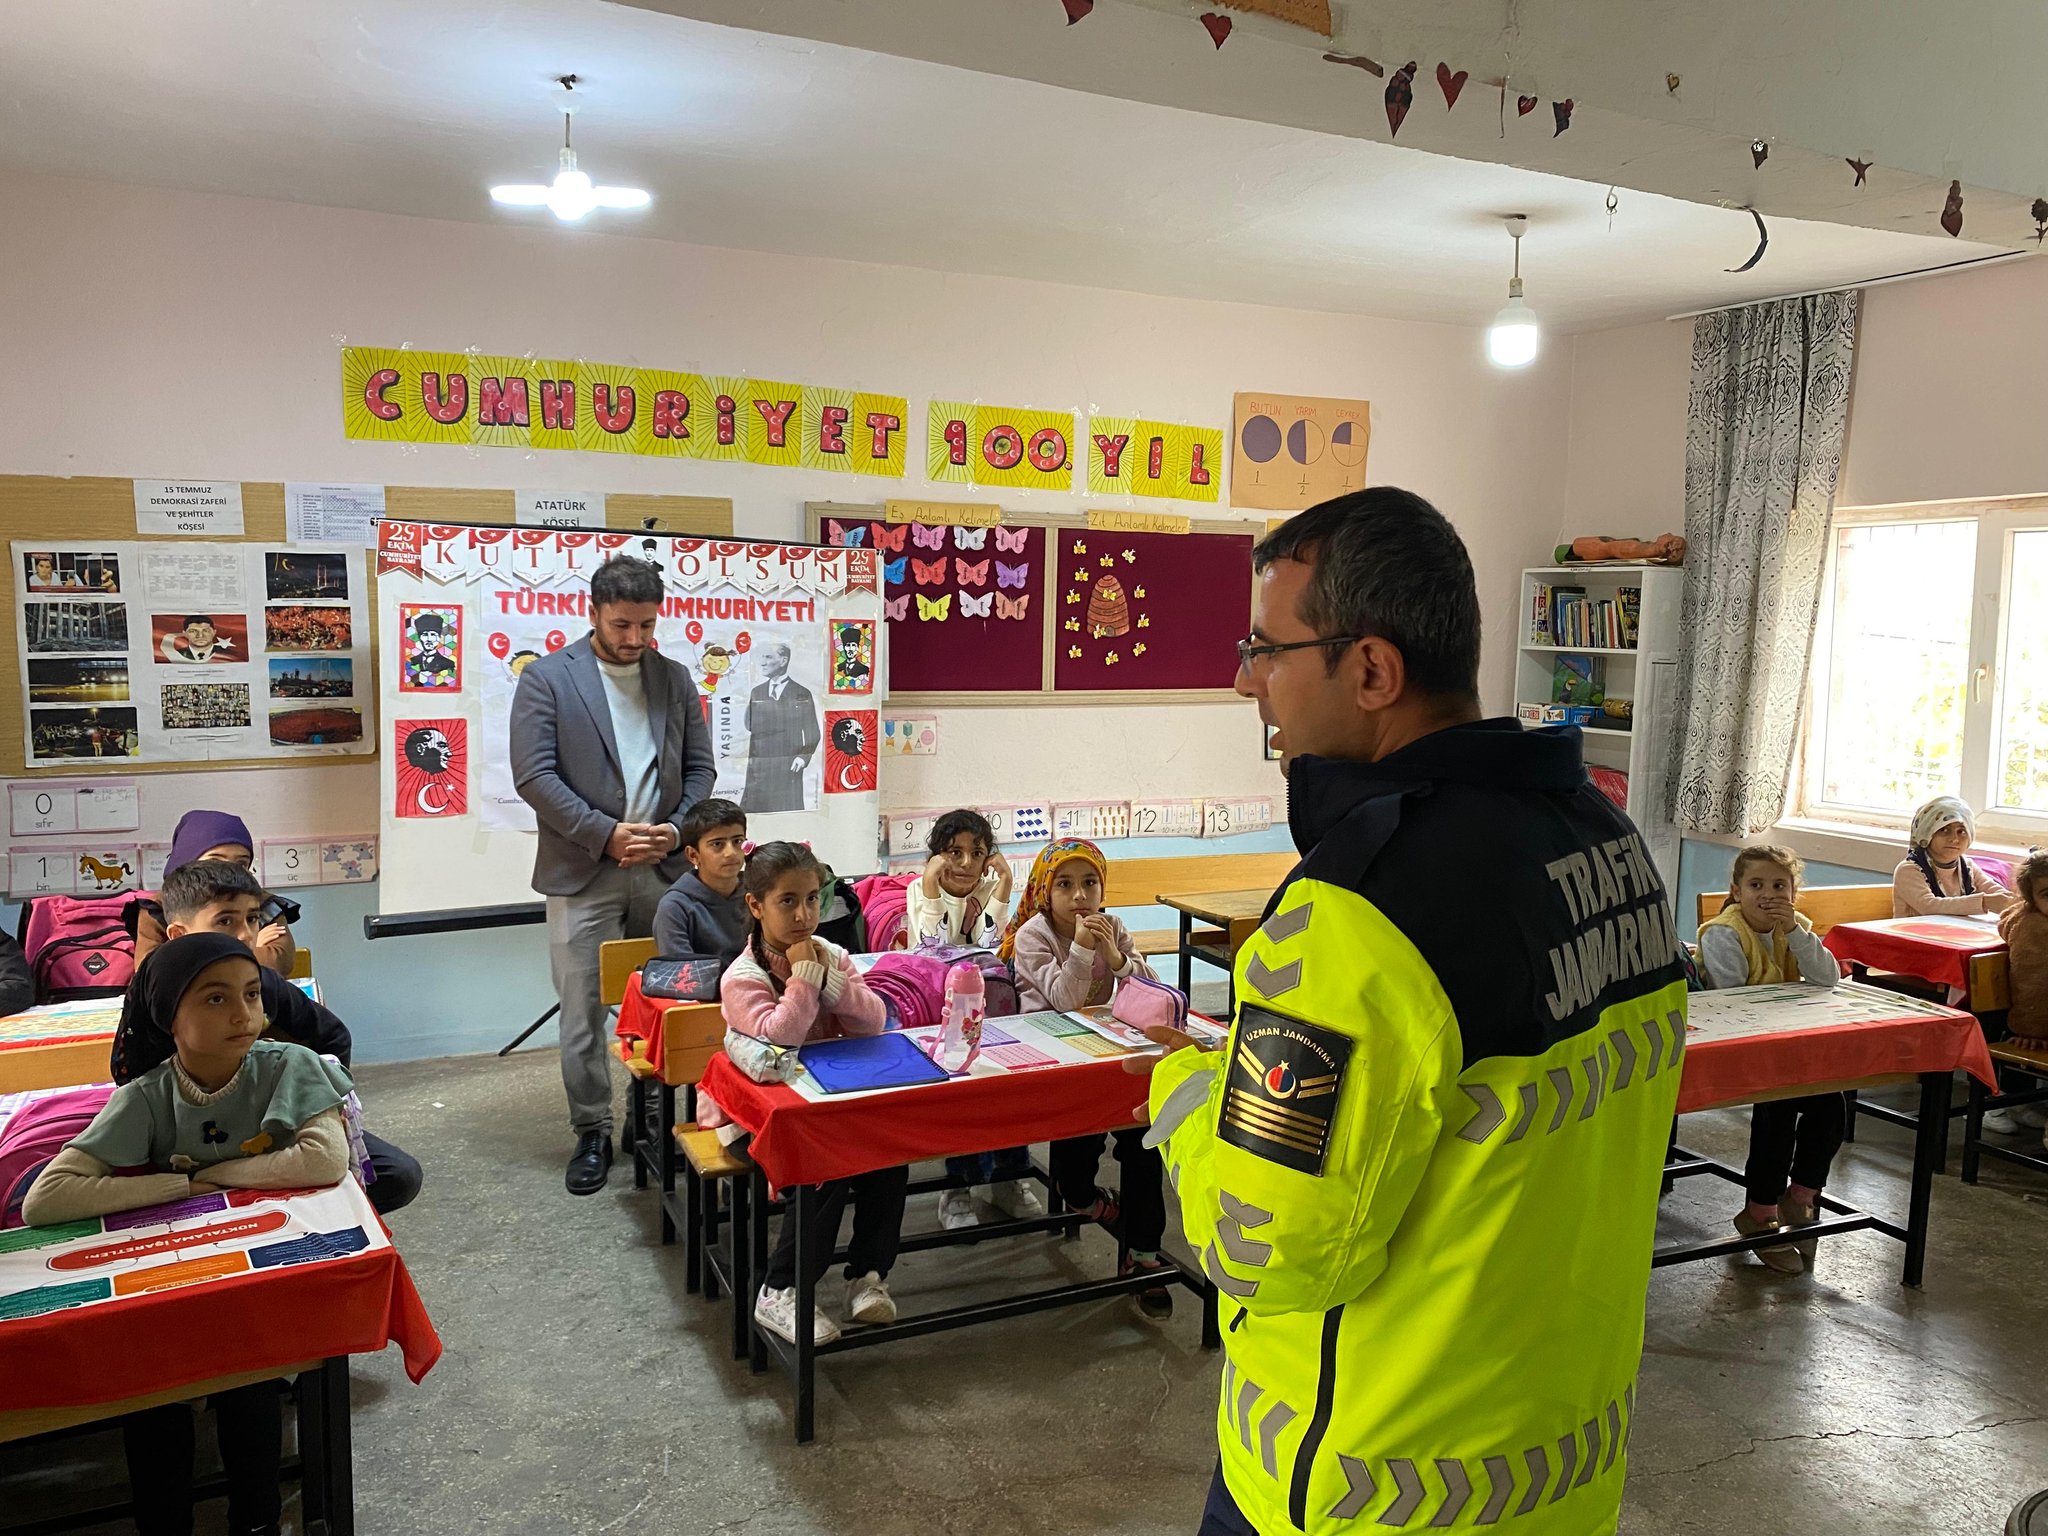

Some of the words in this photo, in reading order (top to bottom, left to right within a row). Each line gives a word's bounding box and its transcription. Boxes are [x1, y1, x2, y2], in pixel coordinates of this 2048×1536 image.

[364, 367, 901, 459] CUMHURİYET
[943, 419, 1073, 473] 100.
[1092, 433, 1211, 485] YIL
[164, 486, 174, 494] 15
[175, 486, 212, 494] TEMMUZ
[150, 497, 199, 505] DEMOKRASİ
[200, 497, 227, 505] ZAFERİ
[534, 499, 587, 511] ATATÜRK
[178, 509, 214, 519] ŞEHİTLER
[177, 522, 205, 531] KÖŞESİ
[388, 523, 416, 541] 29
[387, 540, 417, 553] EKİM
[436, 542, 612, 570] KUTL
[850, 550, 869, 565] 29
[495, 588, 592, 617] TÜRKİ
[657, 595, 815, 623] UMHURİYETİ
[720, 695, 732, 760] YAŞINDA
[35, 793, 52, 814] 0
[1066, 810, 1079, 826] 11
[1134, 810, 1157, 833] 12
[1208, 809, 1230, 832] 13
[904, 822, 914, 840] 9
[37, 856, 47, 878] 1
[285, 848, 299, 868] 3
[1545, 833, 1660, 926] TRAFİK
[1245, 1027, 1280, 1041] UZMAN
[1282, 1029, 1336, 1069] JANDARMA
[171, 1223, 258, 1243] NOKTALAMA
